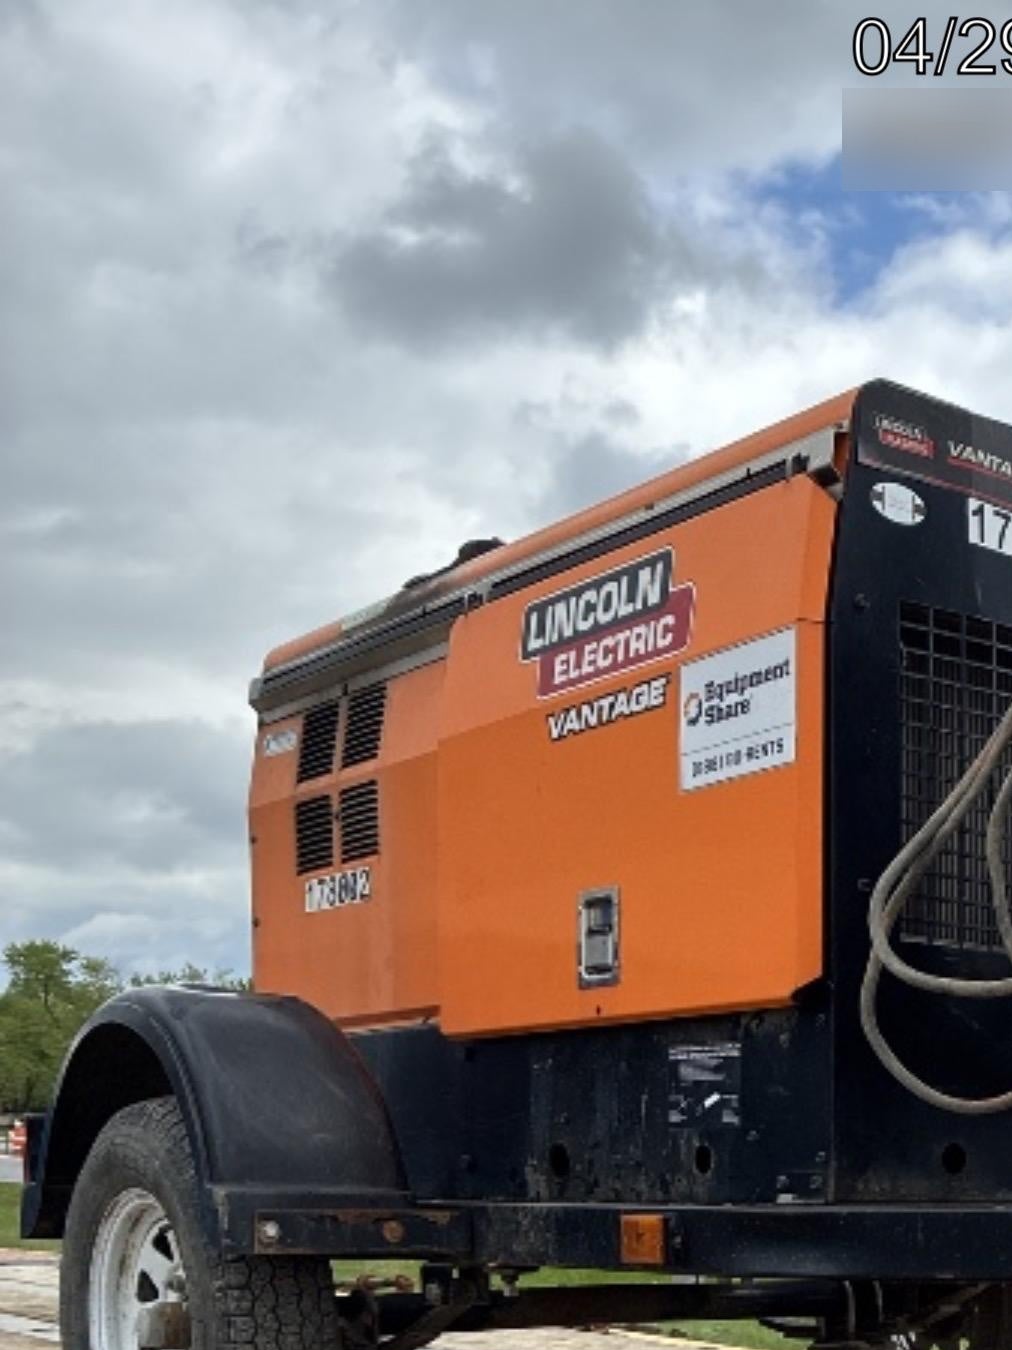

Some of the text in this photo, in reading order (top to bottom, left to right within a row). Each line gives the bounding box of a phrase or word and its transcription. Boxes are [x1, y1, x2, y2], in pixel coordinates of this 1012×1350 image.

[527, 560, 664, 651] LINCOLN
[553, 614, 675, 684] ELECTRIC
[704, 659, 791, 703] Equipment
[547, 674, 669, 741] VANTAGE
[704, 698, 751, 726] Share
